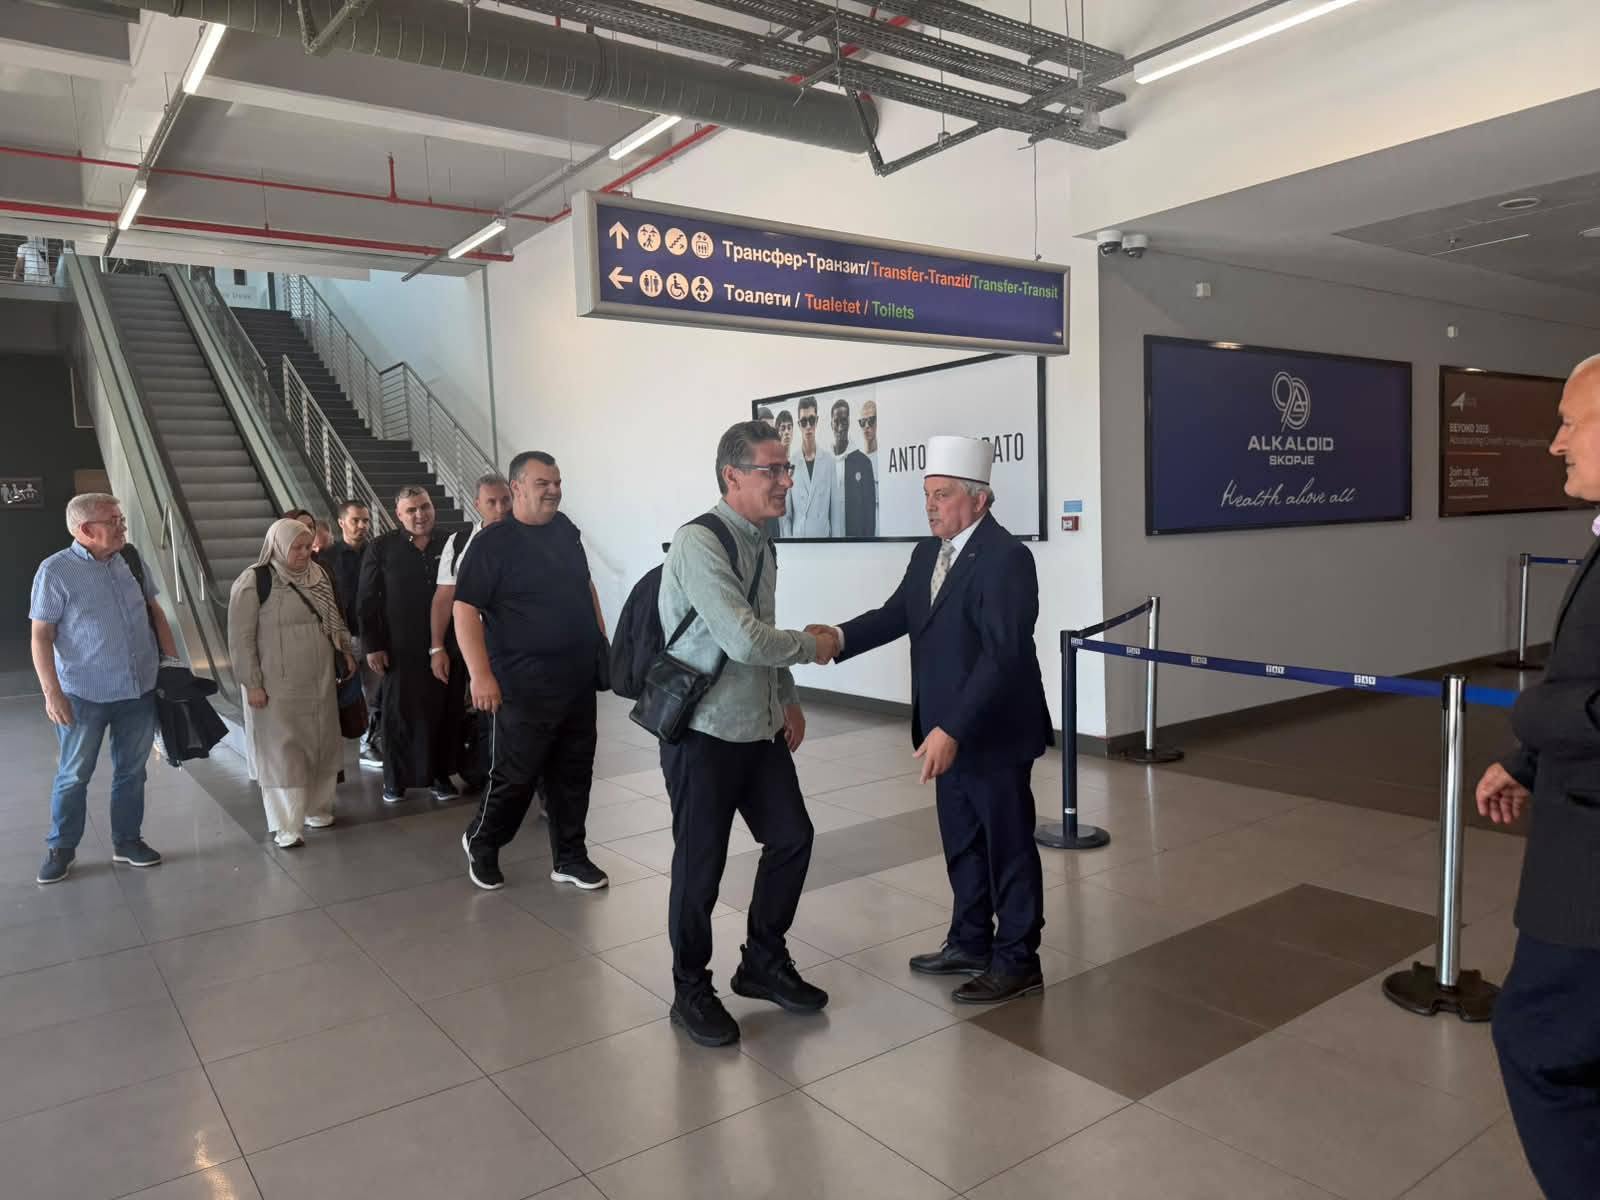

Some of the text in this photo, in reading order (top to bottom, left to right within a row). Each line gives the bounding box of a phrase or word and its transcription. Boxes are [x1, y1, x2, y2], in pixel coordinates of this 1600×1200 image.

[724, 284, 792, 307] Тоалети
[805, 293, 861, 314] Tualetet
[872, 300, 915, 320] Toilets
[889, 433, 1024, 472] ANTO ATO
[1247, 435, 1334, 451] ALKALOID
[1269, 455, 1315, 465] SKOPJE
[1221, 477, 1356, 507] Health above all
